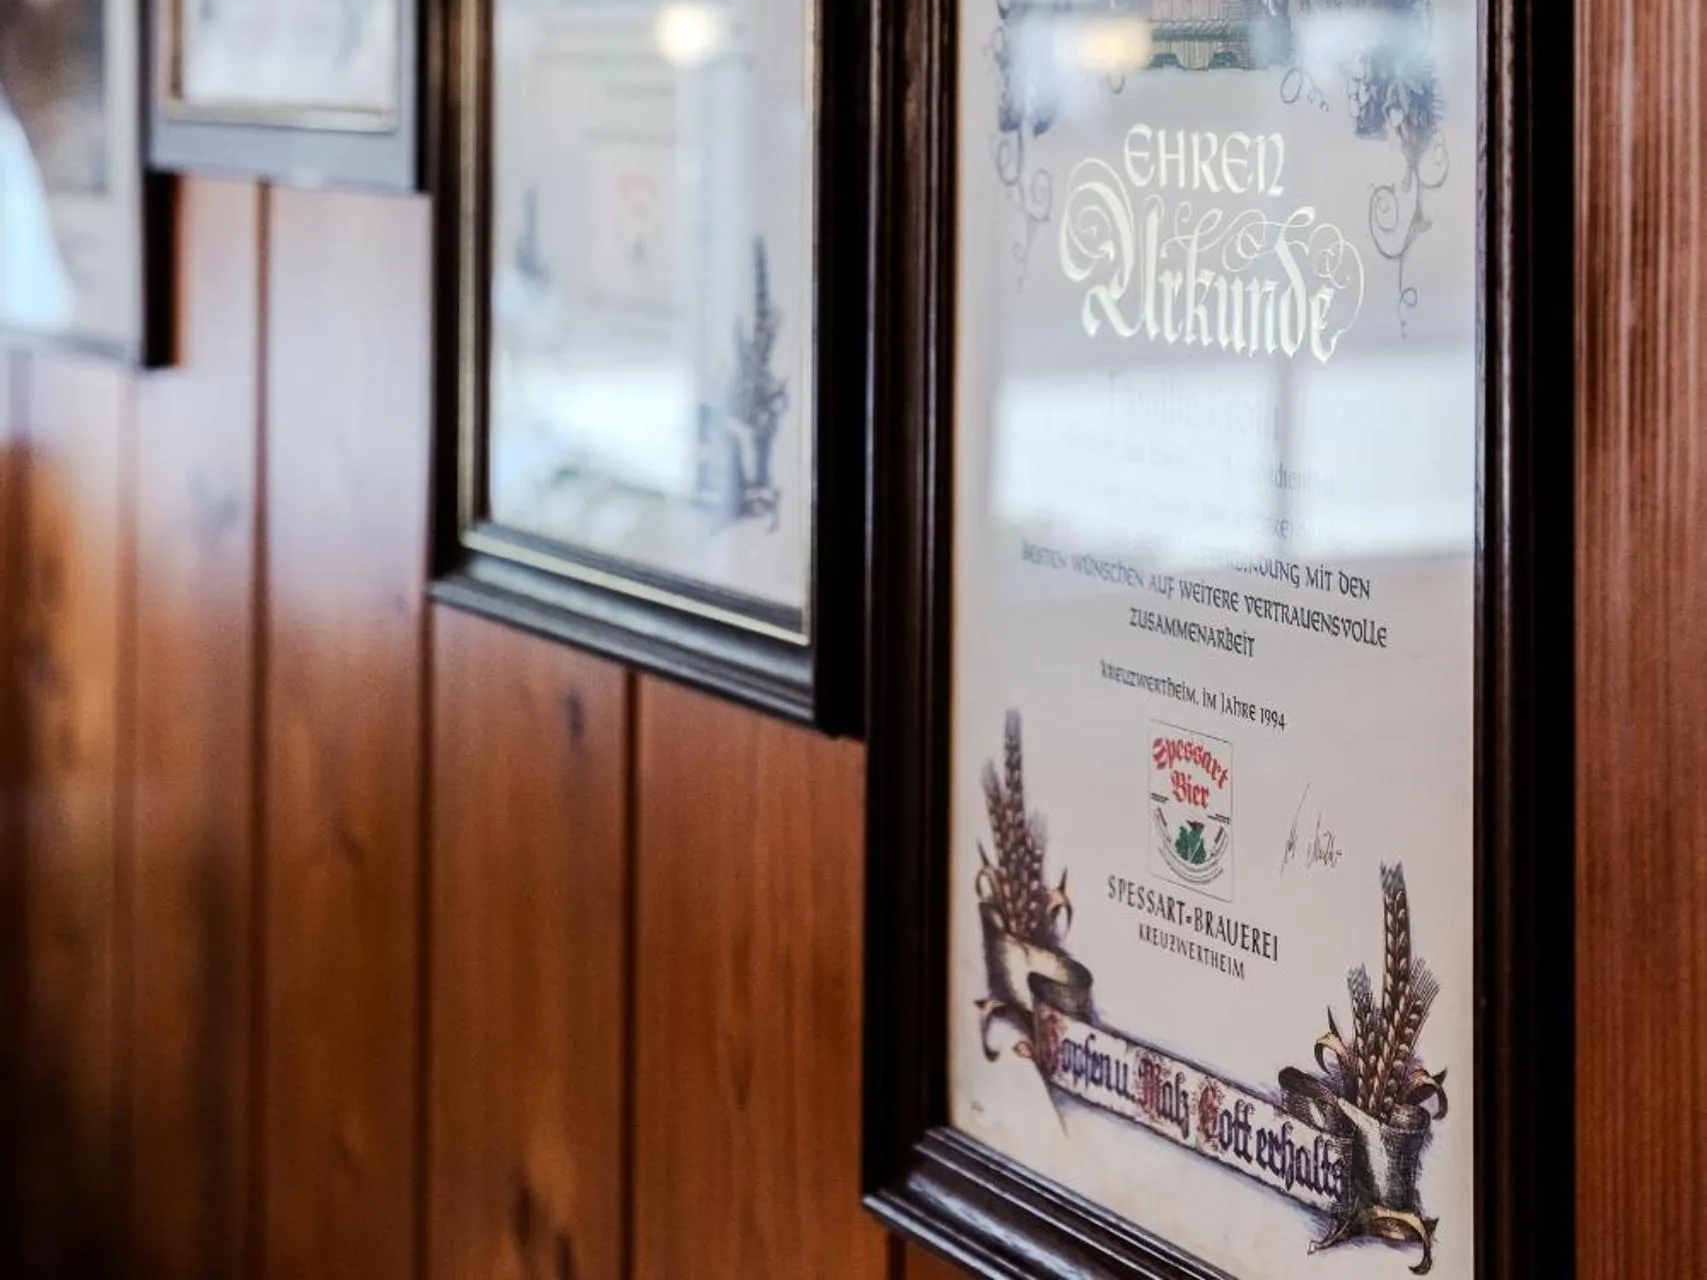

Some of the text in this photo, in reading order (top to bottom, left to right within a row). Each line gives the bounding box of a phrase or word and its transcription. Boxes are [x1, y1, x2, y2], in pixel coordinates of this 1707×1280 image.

[1124, 123, 1285, 197] EHREN
[1060, 157, 1365, 363] Urkunde
[1148, 572, 1176, 600] AUF
[1244, 593, 1388, 649] VERTRAUENSVOLLE
[1338, 570, 1372, 600] DEN
[1129, 606, 1256, 658] ZUSAMMENARBEIT
[1259, 706, 1287, 732] 1994
[1152, 735, 1230, 790] Spessart
[1170, 769, 1210, 810] Bier
[1138, 922, 1246, 981] KREUZWERTHEIM
